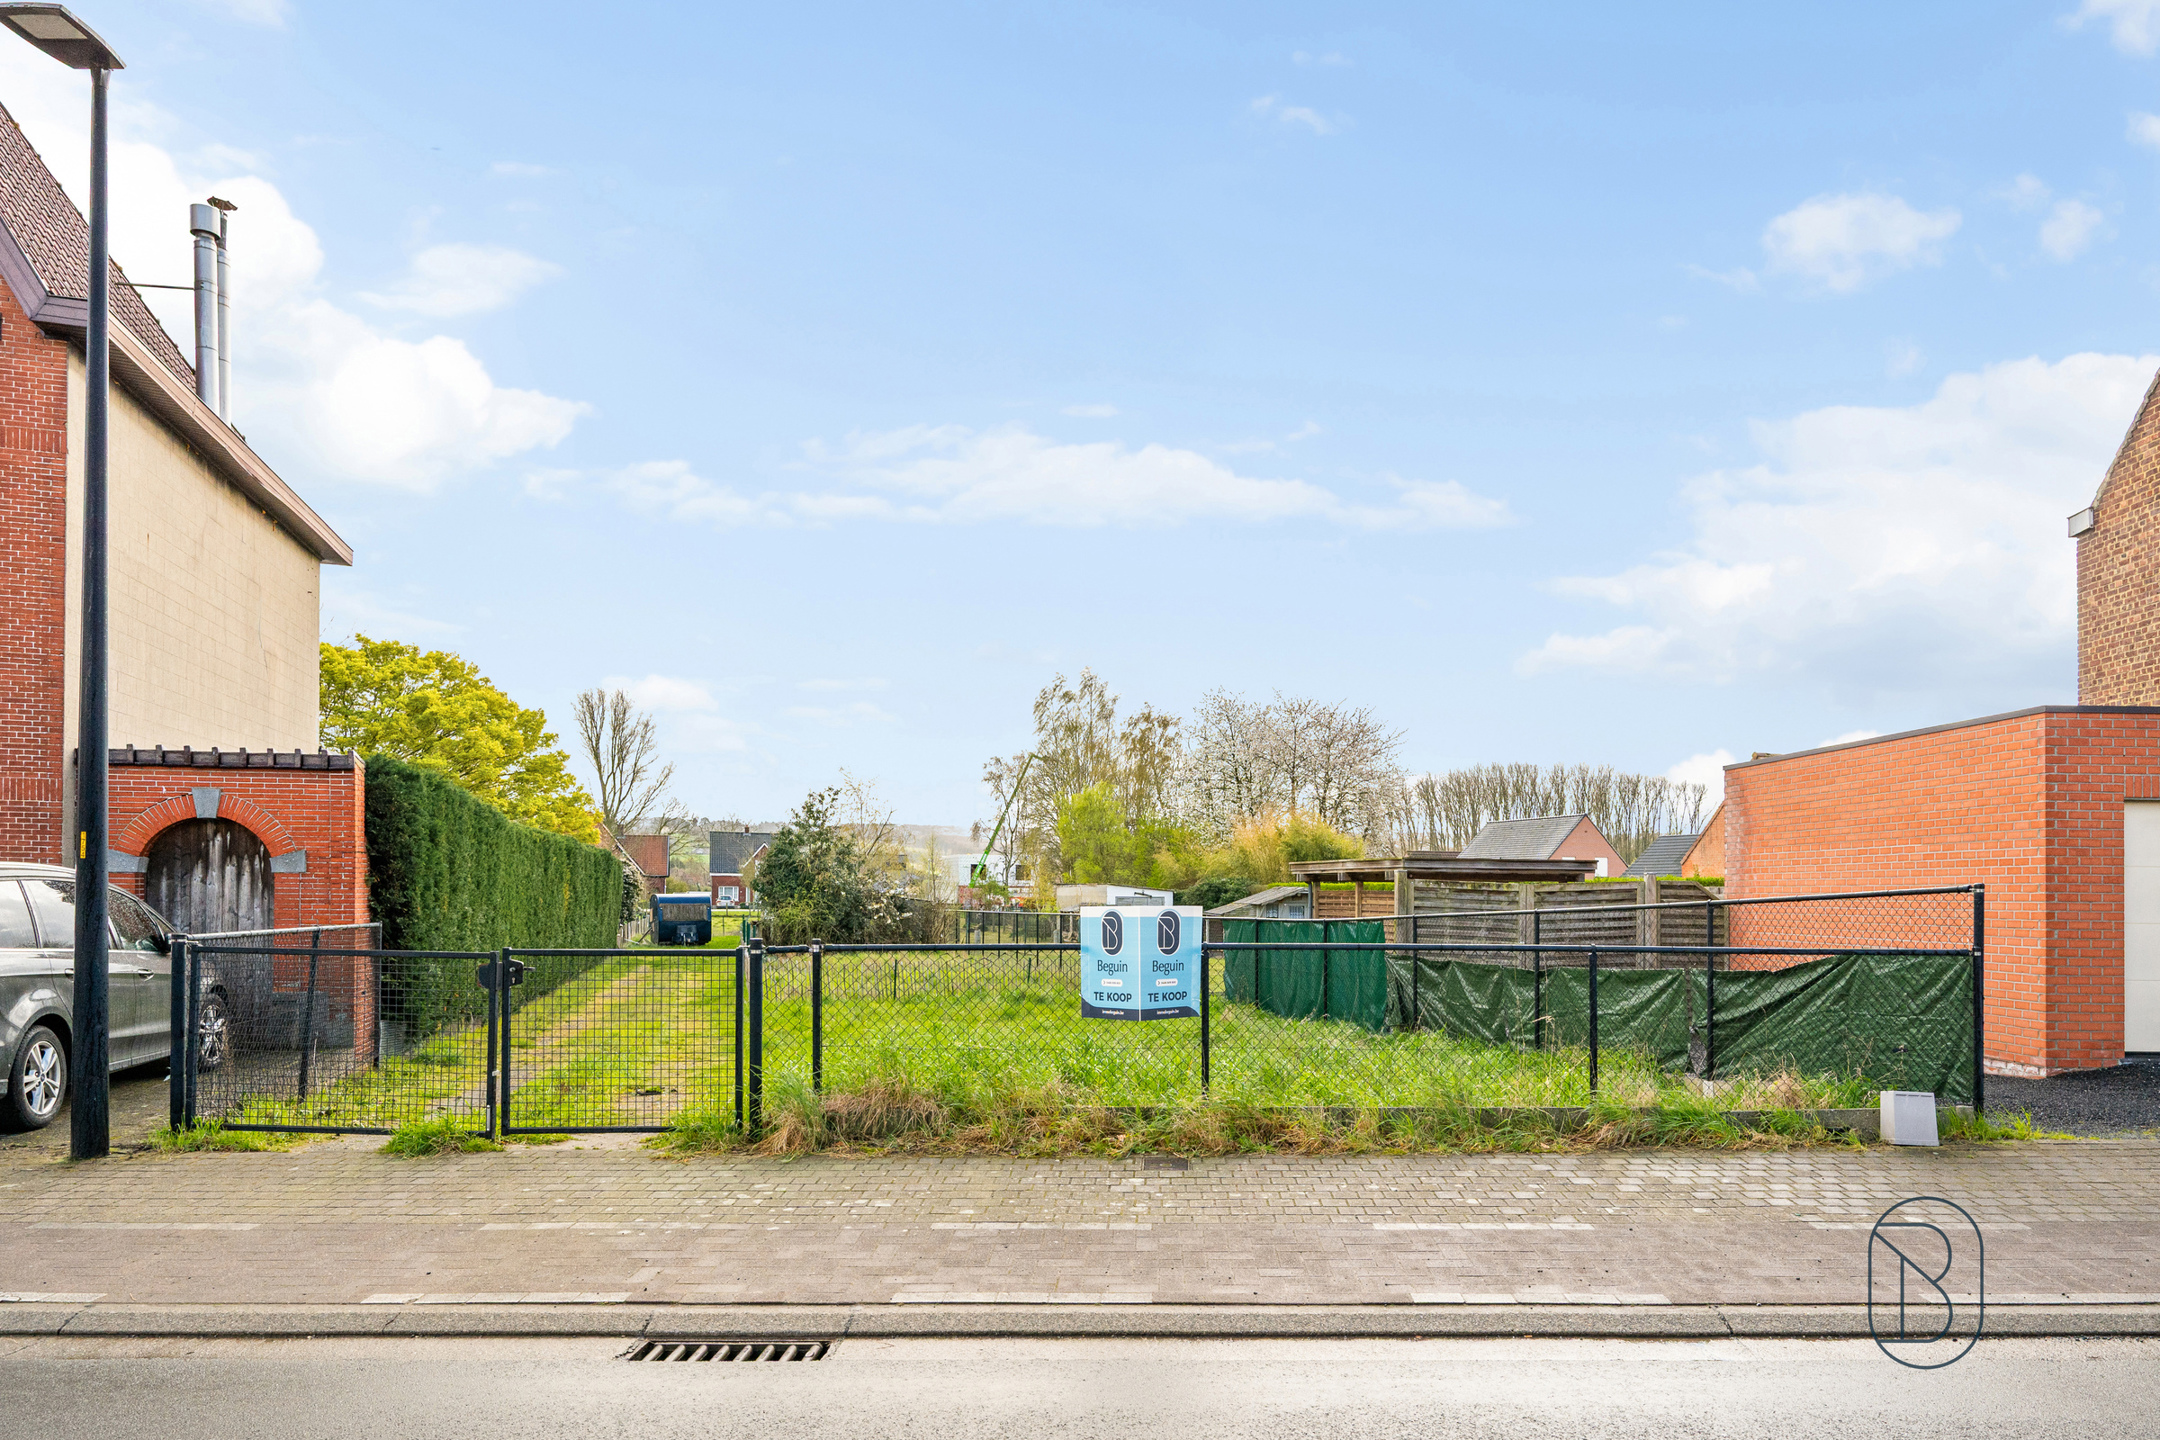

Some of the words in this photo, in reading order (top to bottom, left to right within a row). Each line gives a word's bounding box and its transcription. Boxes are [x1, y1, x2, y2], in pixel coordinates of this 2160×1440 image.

[1097, 960, 1128, 976] Beguin
[1152, 960, 1185, 976] Beguin
[1093, 991, 1104, 1001] TE
[1107, 992, 1132, 1003] KOOP
[1148, 993, 1159, 1003] TE
[1161, 991, 1188, 1002] KOOP
